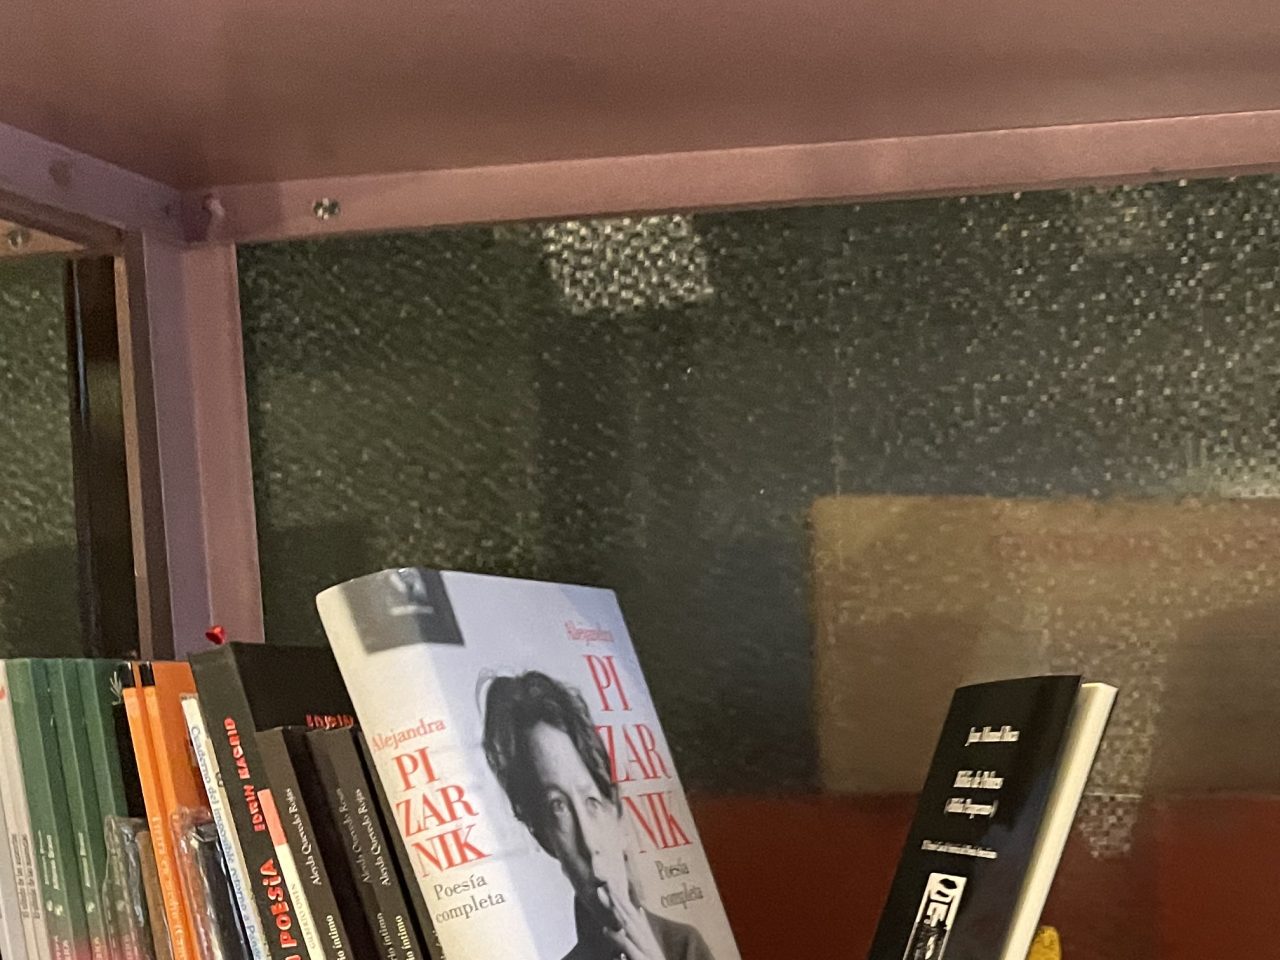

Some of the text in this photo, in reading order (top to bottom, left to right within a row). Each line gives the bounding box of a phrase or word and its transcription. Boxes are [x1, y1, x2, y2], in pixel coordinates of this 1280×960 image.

[584, 654, 632, 712] PI
[370, 716, 446, 753] Alejandra
[595, 724, 672, 784] ZAR
[392, 746, 440, 792] PI
[206, 786, 219, 805] del
[396, 784, 479, 838] ZAR
[622, 791, 693, 853] NIK
[412, 824, 492, 878] NIK
[433, 873, 488, 901] Poesía
[435, 892, 506, 924] completa
